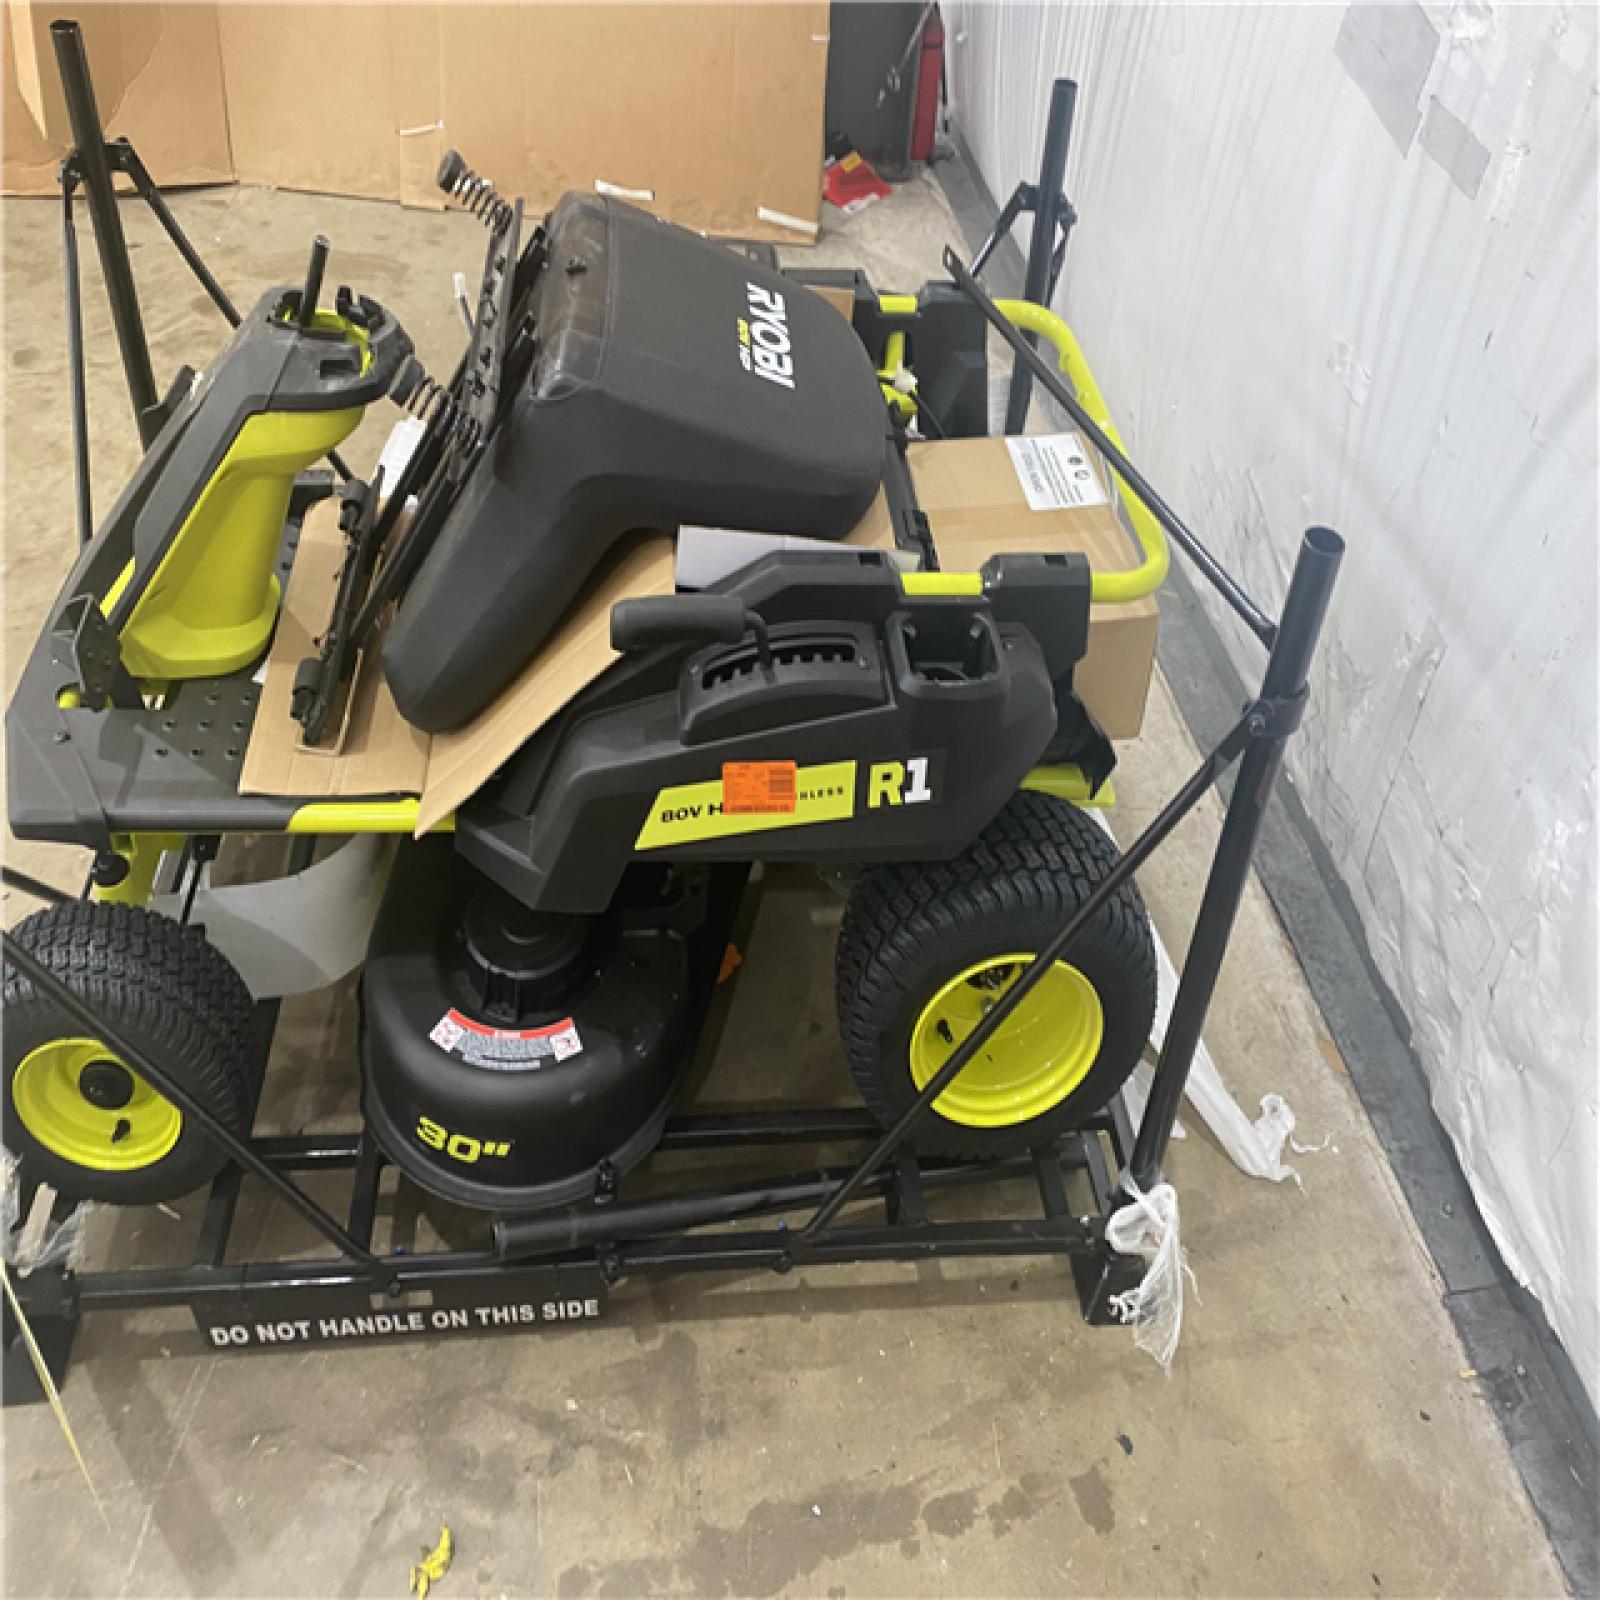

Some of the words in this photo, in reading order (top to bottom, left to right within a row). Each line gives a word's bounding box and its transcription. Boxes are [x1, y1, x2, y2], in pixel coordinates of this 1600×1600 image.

[745, 281, 797, 389] RYOBI
[795, 785, 844, 801] HLESS
[868, 756, 932, 809] R1
[209, 1325, 250, 1346] DO
[255, 1319, 311, 1343] NOT
[319, 1311, 426, 1338] HANDLE
[431, 1309, 469, 1329] ON
[474, 1304, 536, 1326] THIS
[542, 1298, 599, 1321] SIDE
